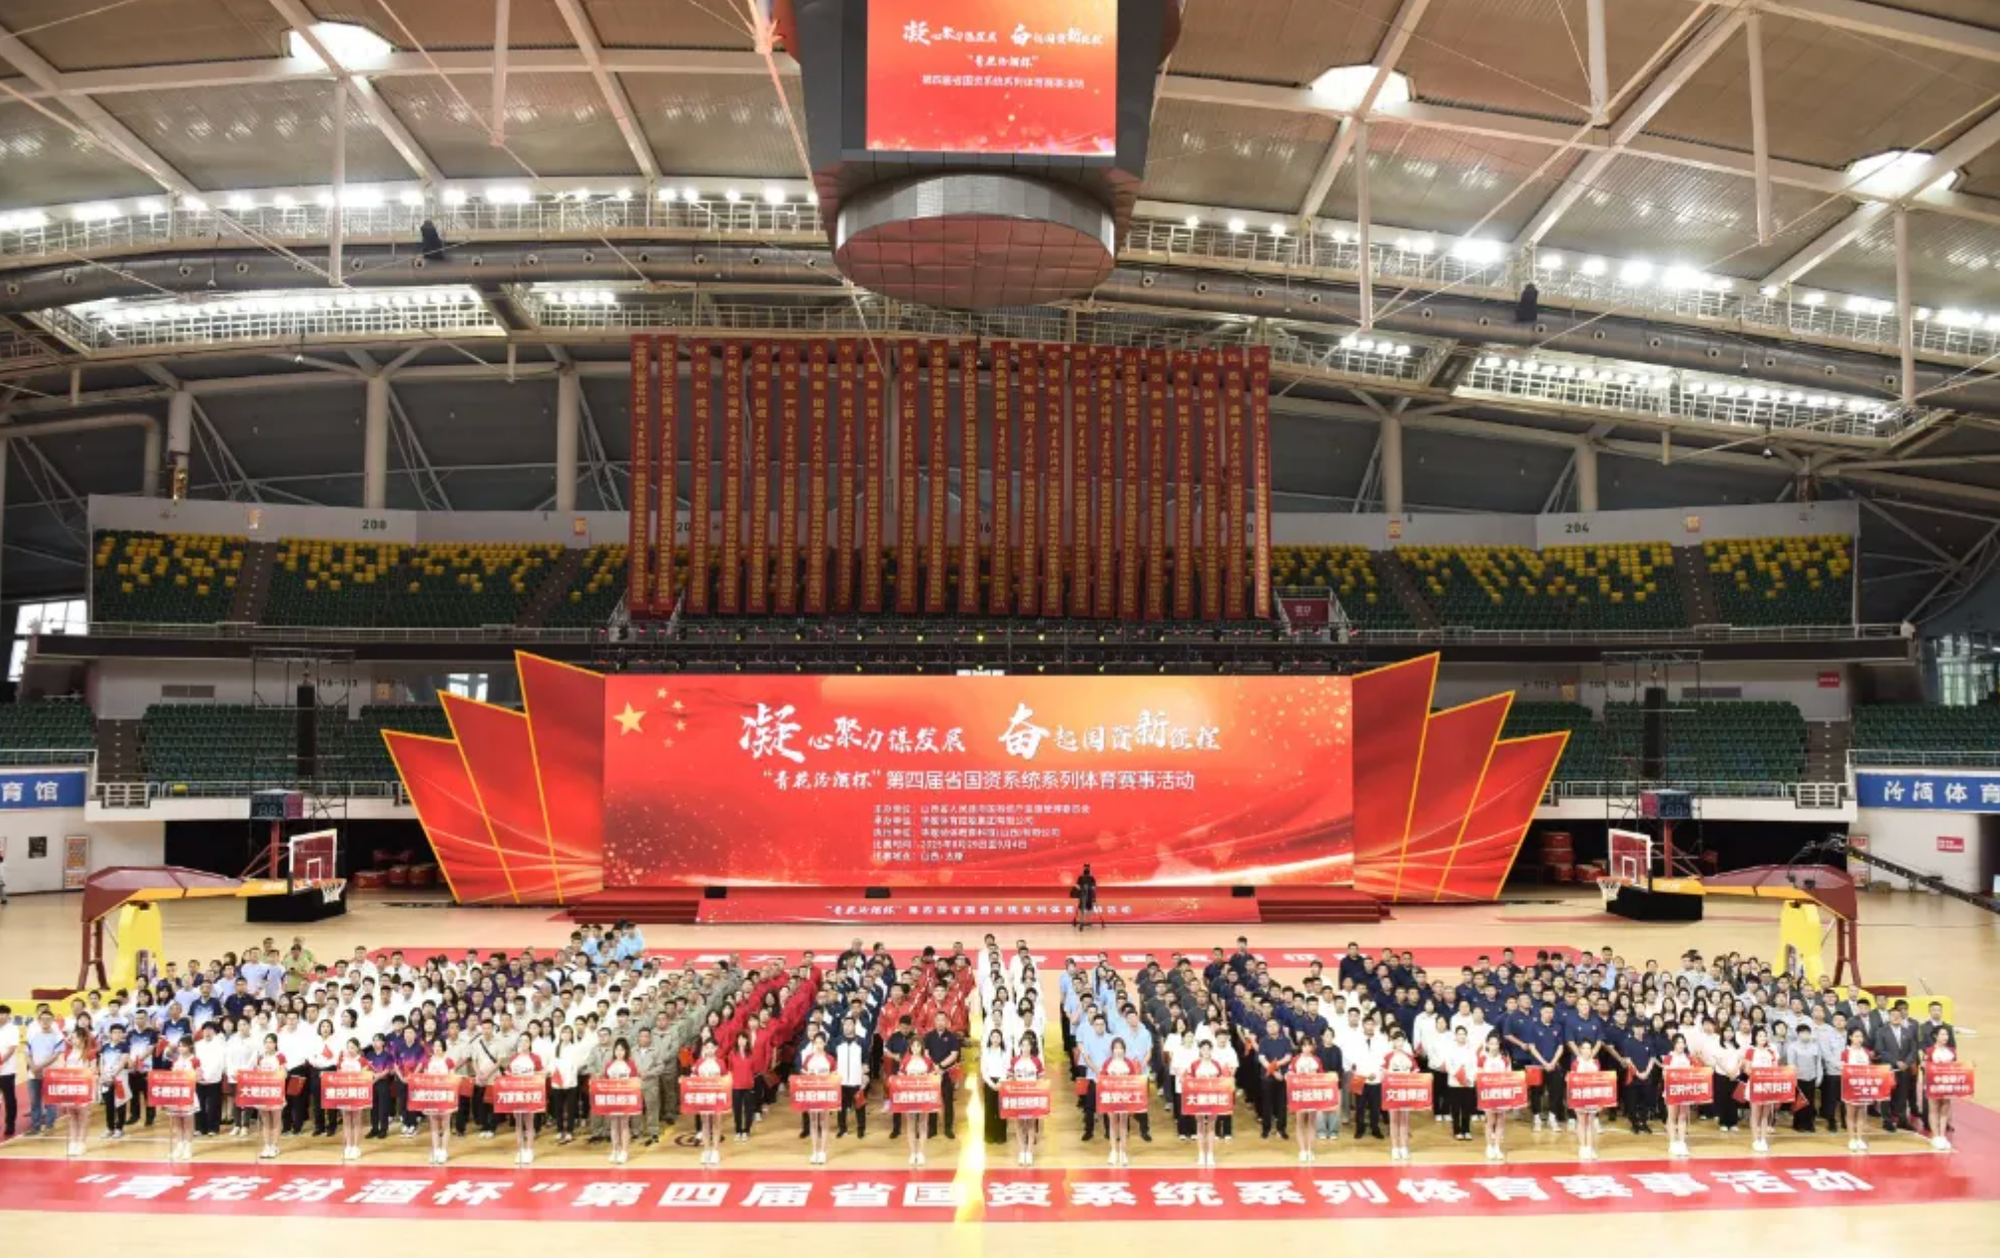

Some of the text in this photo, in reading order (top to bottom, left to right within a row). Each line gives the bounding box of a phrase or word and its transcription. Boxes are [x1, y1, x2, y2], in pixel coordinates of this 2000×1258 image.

[362, 519, 387, 531] 208
[1565, 522, 1590, 534] 204
[739, 703, 1221, 763] 凝心聚力谋发展 奋起国资新征程
